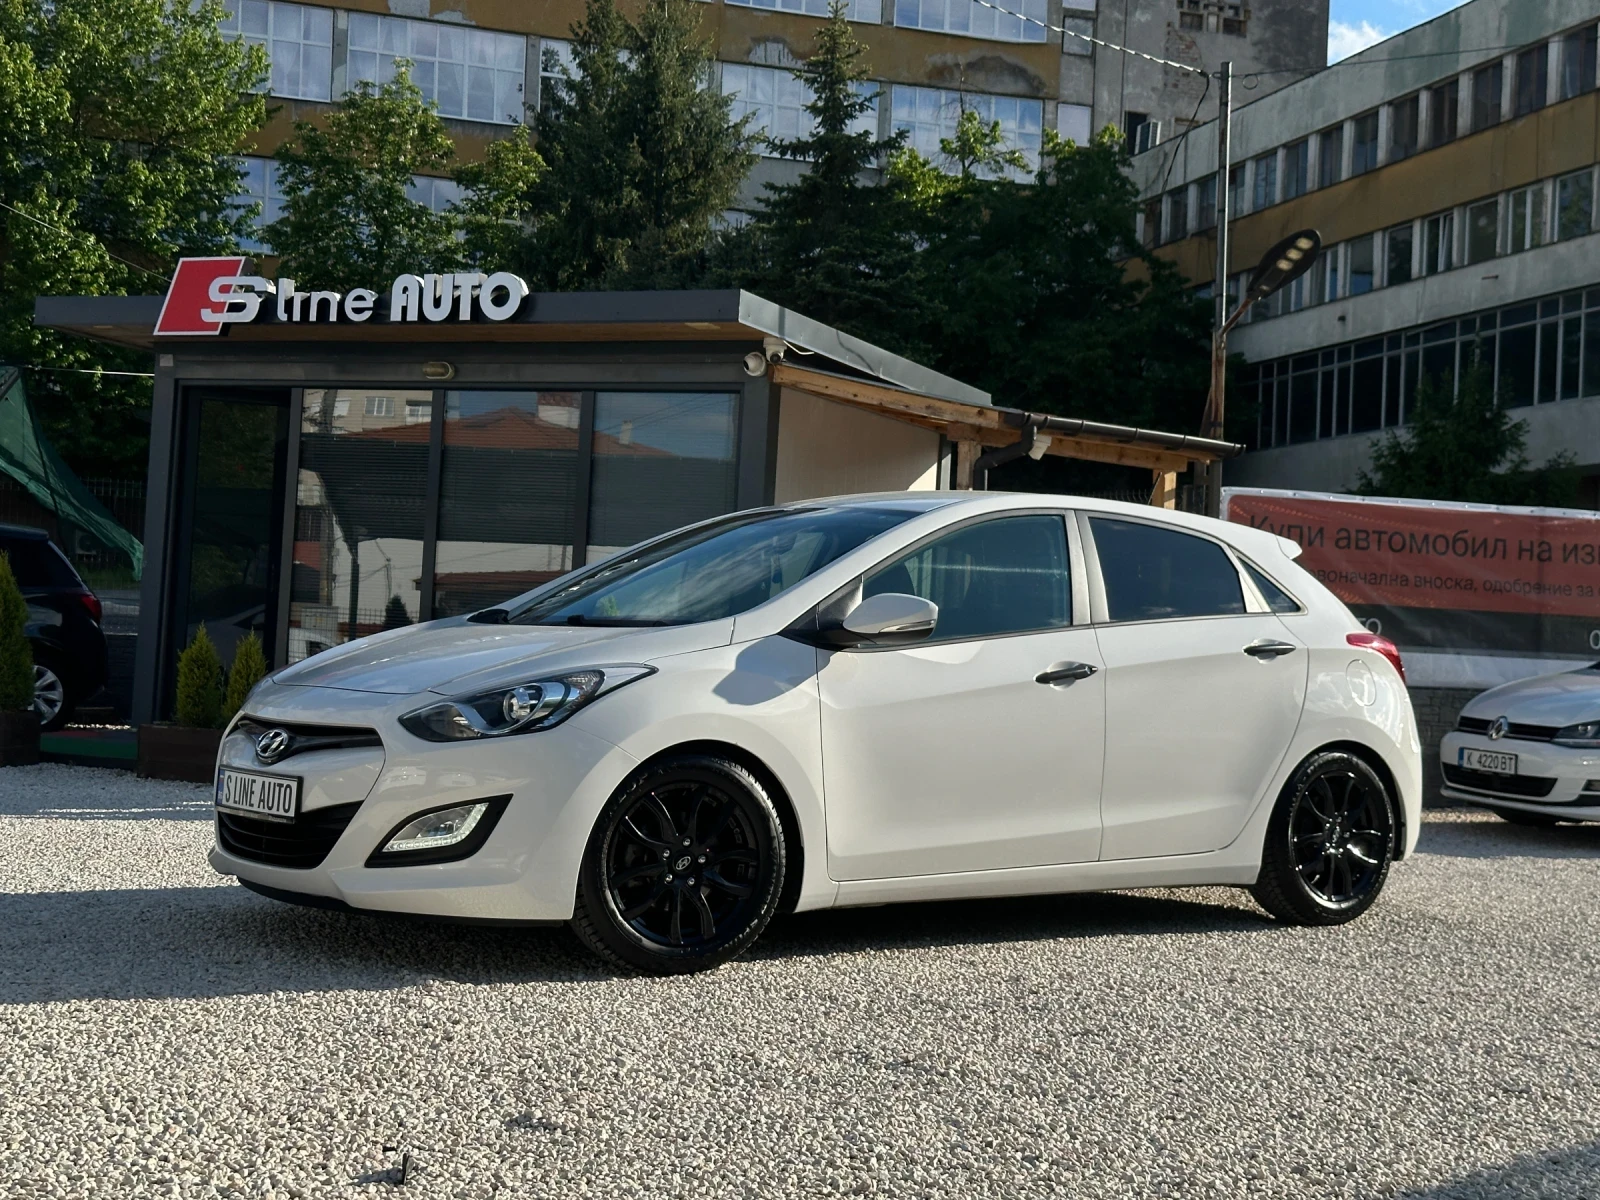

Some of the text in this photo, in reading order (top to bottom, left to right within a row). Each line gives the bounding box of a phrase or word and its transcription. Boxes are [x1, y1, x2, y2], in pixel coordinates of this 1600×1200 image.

[201, 276, 274, 322] S
[390, 271, 529, 322] AUTO
[1335, 527, 1507, 560] автомобил
[1517, 539, 1553, 563] на
[1562, 542, 1600, 567] из
[1414, 575, 1478, 593] вноска,
[1482, 578, 1573, 598] одобрение
[1576, 584, 1594, 598] за
[1466, 752, 1513, 771] K 4220 BT
[226, 775, 292, 813] S LINE AUTO
